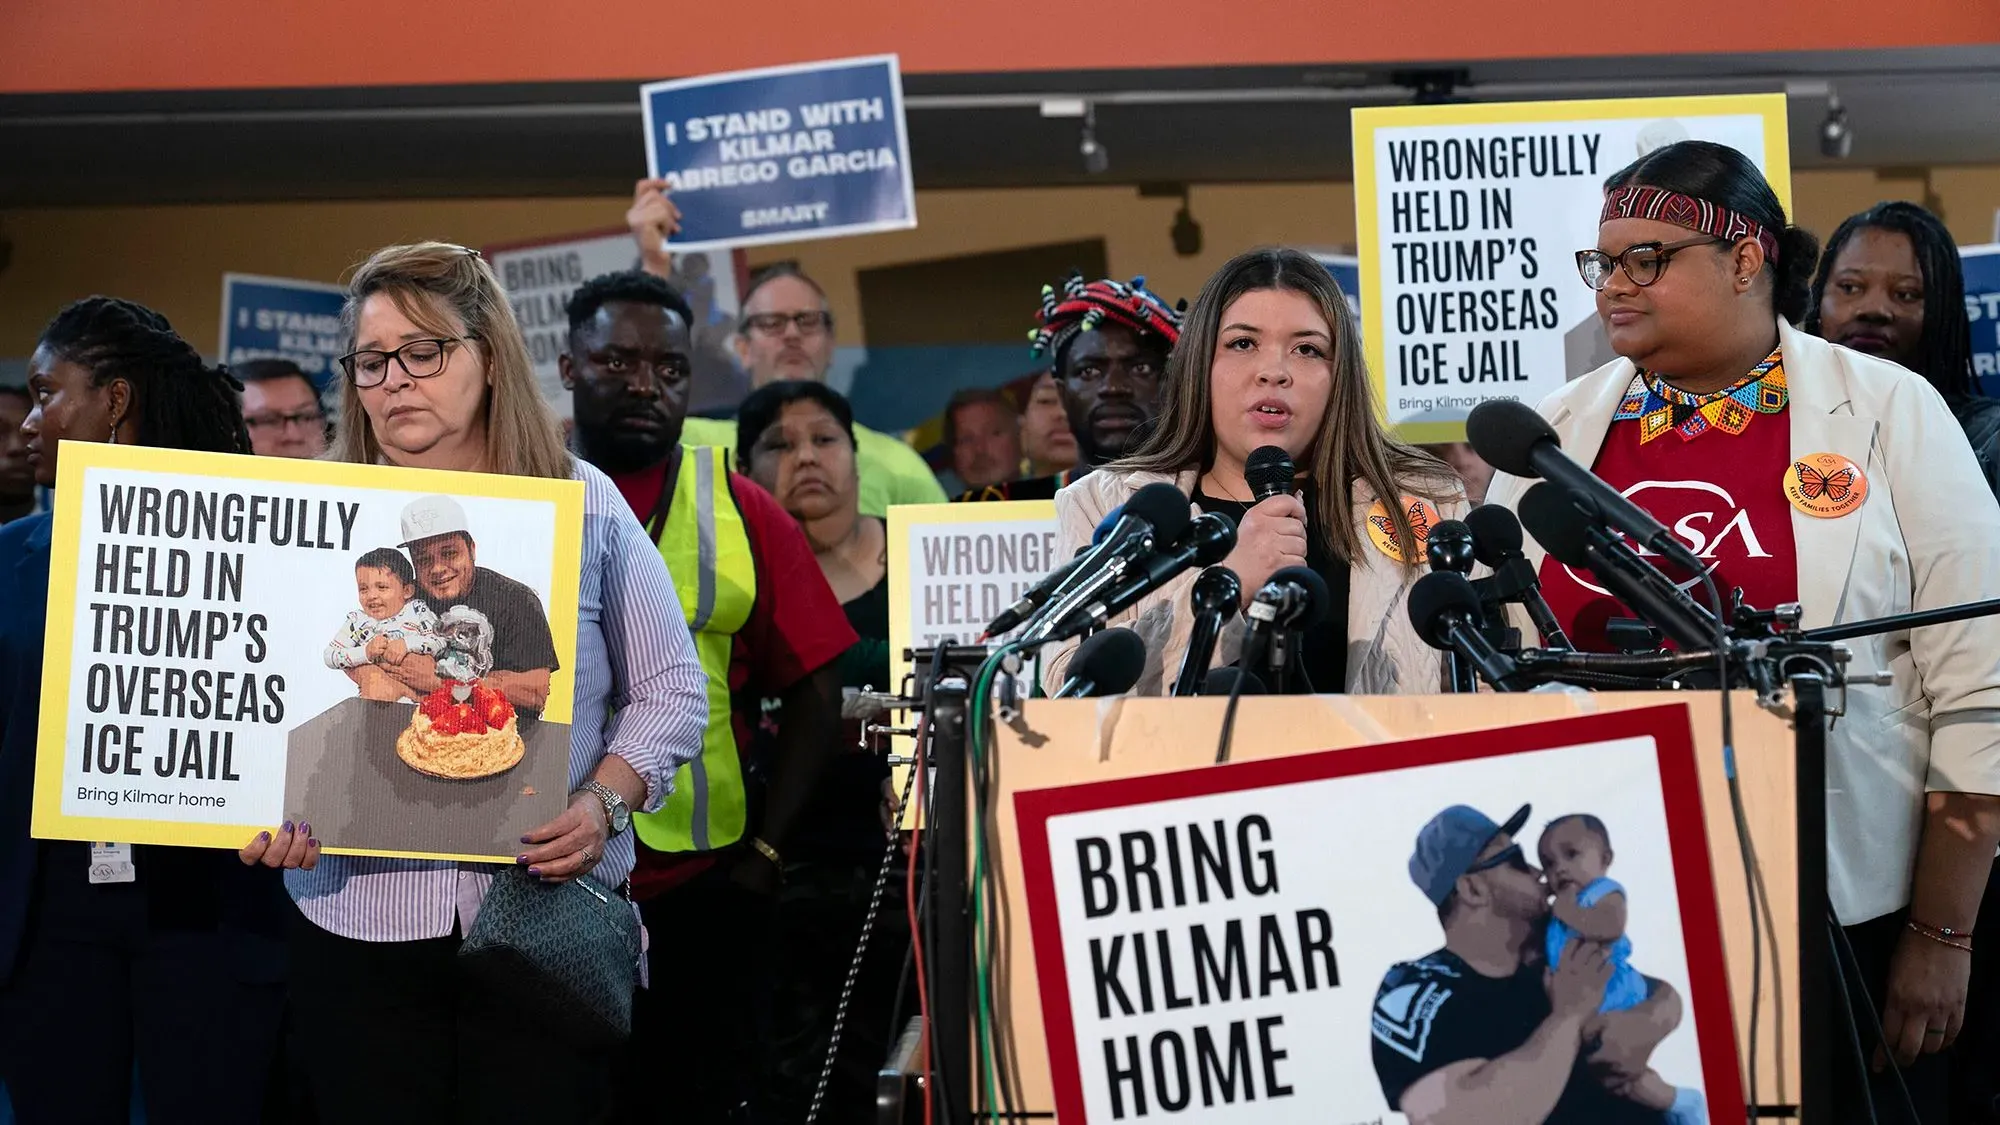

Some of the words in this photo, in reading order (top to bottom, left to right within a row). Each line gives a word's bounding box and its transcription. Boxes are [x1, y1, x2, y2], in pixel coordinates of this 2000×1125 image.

[666, 122, 677, 145] I
[687, 107, 791, 141] STAND
[801, 98, 884, 127] WITH
[720, 130, 836, 161] KILMAR
[1388, 133, 1601, 183] WRONGFULLY
[665, 163, 779, 192] ABREGO
[788, 147, 897, 178] GARCIA
[741, 202, 829, 228] SMART
[1392, 189, 1469, 234] HELD
[1480, 187, 1513, 230] IN
[504, 252, 583, 291] BRING
[1396, 287, 1559, 336] OVERSEAS
[1399, 342, 1449, 387] ICE
[1458, 339, 1529, 384] JAIL
[1399, 398, 1433, 412] Bring
[1436, 396, 1480, 408] Kilmar
[99, 483, 360, 552] WRONGFULLY
[1789, 486, 1801, 500] KEEP
[1799, 498, 1830, 512] FAMILIES
[1831, 491, 1860, 512] TOGETHER
[1382, 541, 1397, 552] KEEP
[94, 543, 191, 598] HELD
[203, 551, 244, 603] IN
[924, 584, 1000, 625] HELD
[86, 663, 286, 724] OVERSEAS
[82, 723, 145, 776] ICE
[154, 728, 240, 782] JAIL
[77, 786, 119, 806] Bring
[123, 789, 175, 805] Kilmar
[178, 791, 226, 808] home
[1076, 814, 1279, 919] BRING
[1089, 908, 1340, 1019] KILMAR
[1102, 1015, 1294, 1120] HOME
